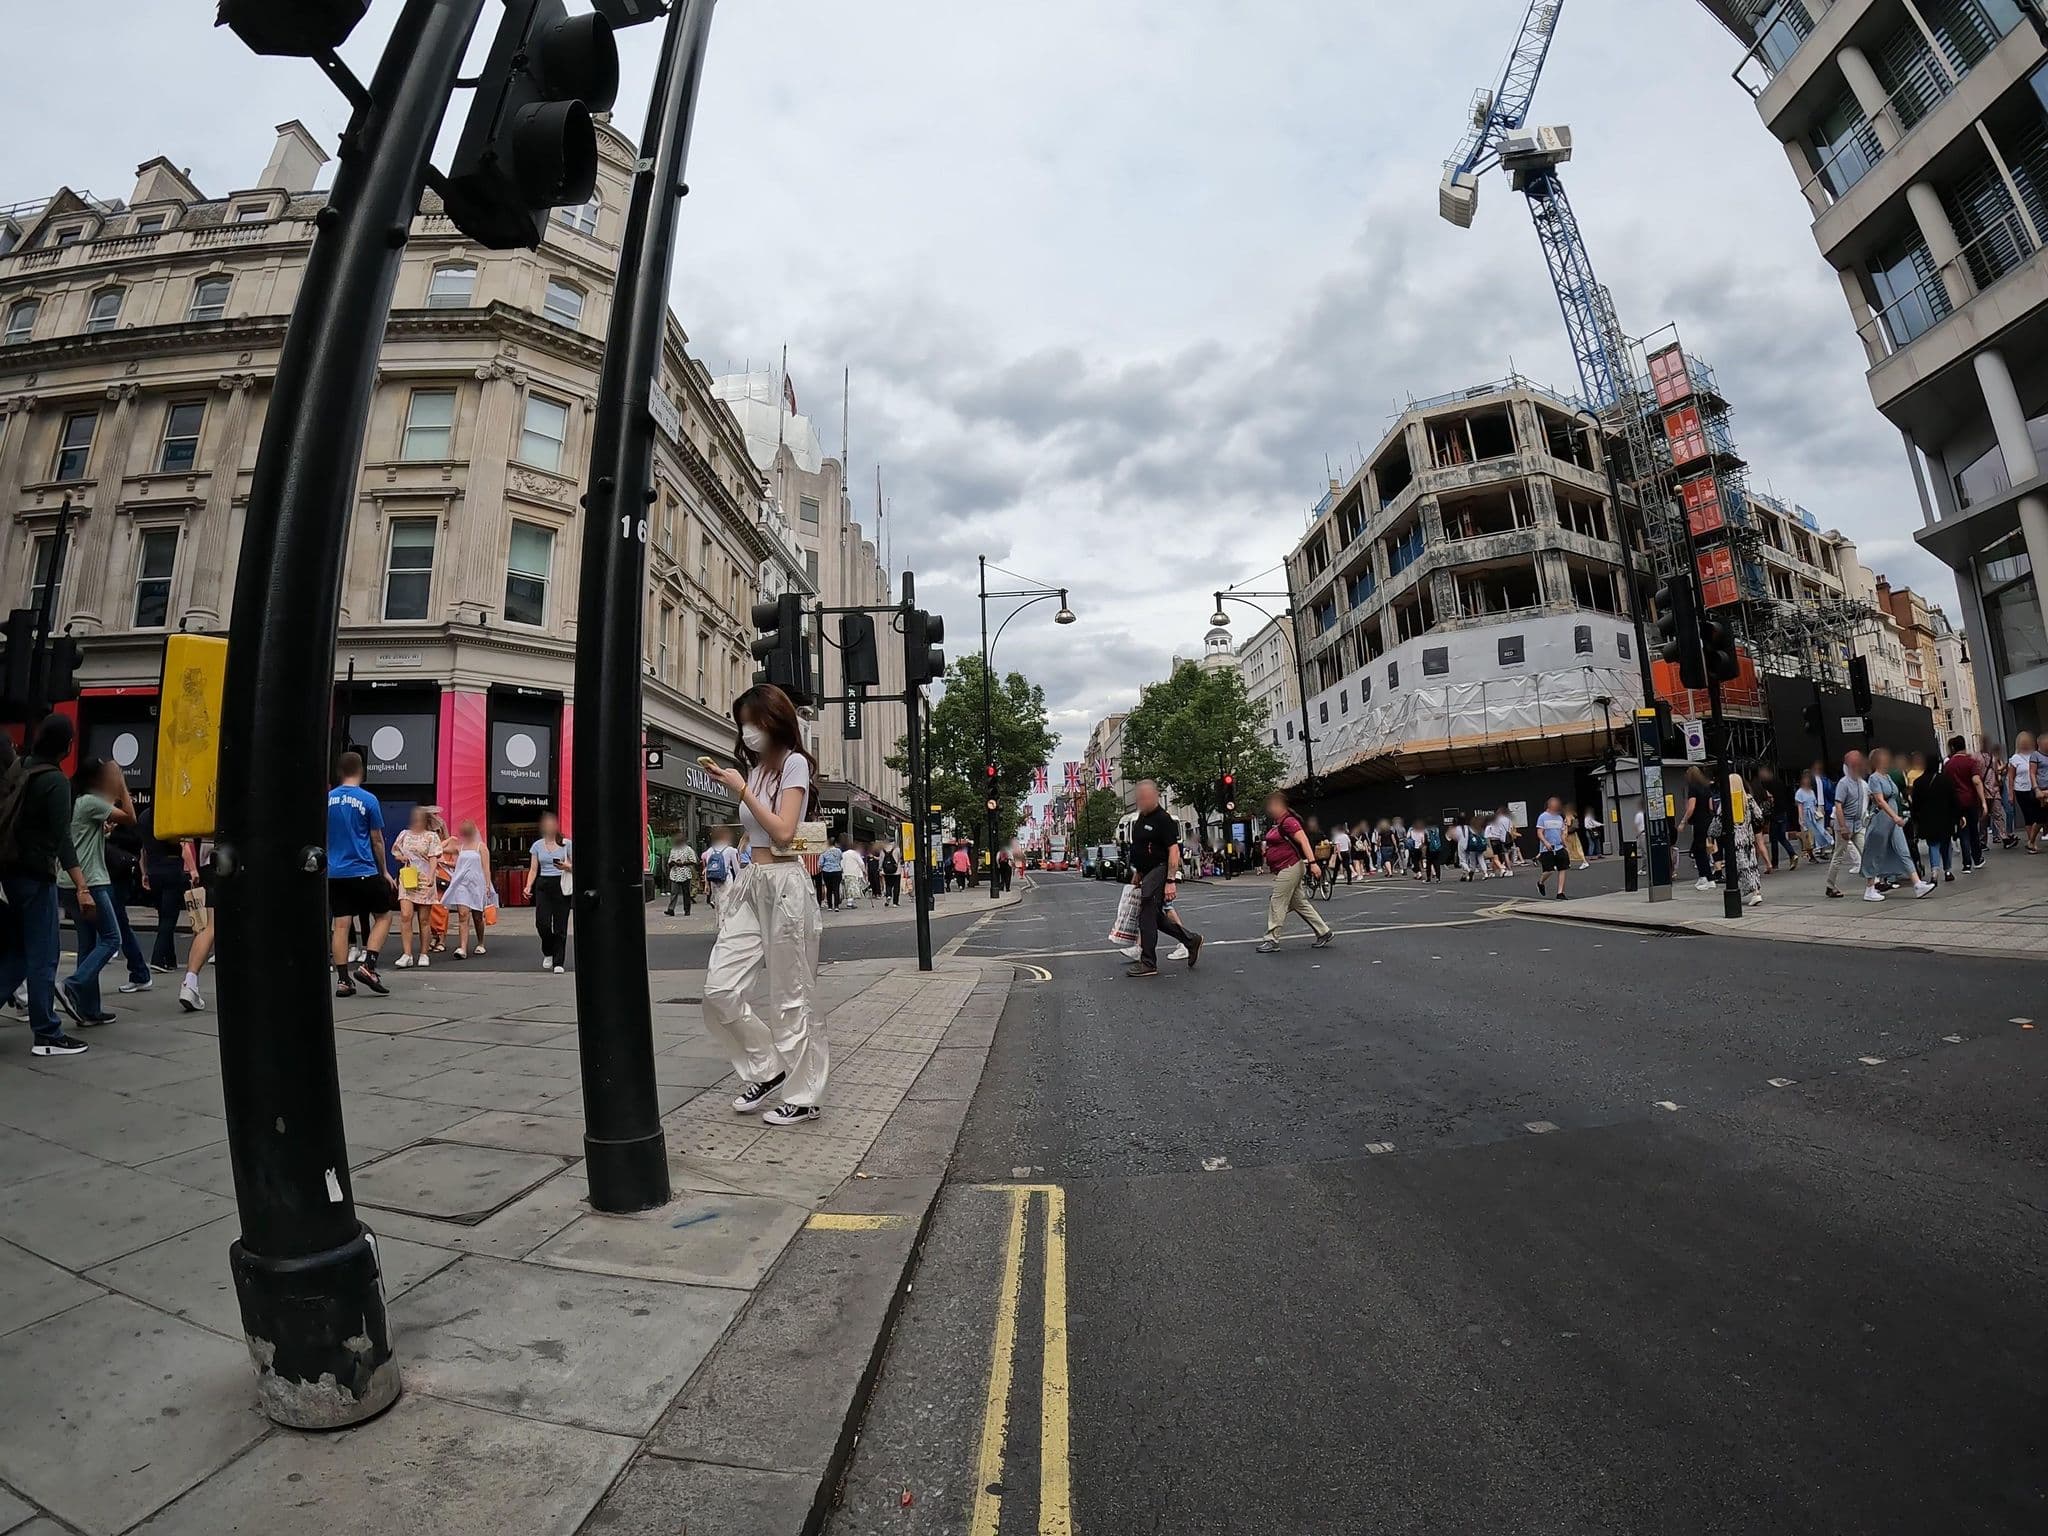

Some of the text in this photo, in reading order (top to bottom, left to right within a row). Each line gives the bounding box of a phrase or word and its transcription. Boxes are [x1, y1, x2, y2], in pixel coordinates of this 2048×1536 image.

[395, 762, 407, 771] hut
[500, 768, 540, 779] sunglass hut
[507, 797, 548, 806] sunglass hut
